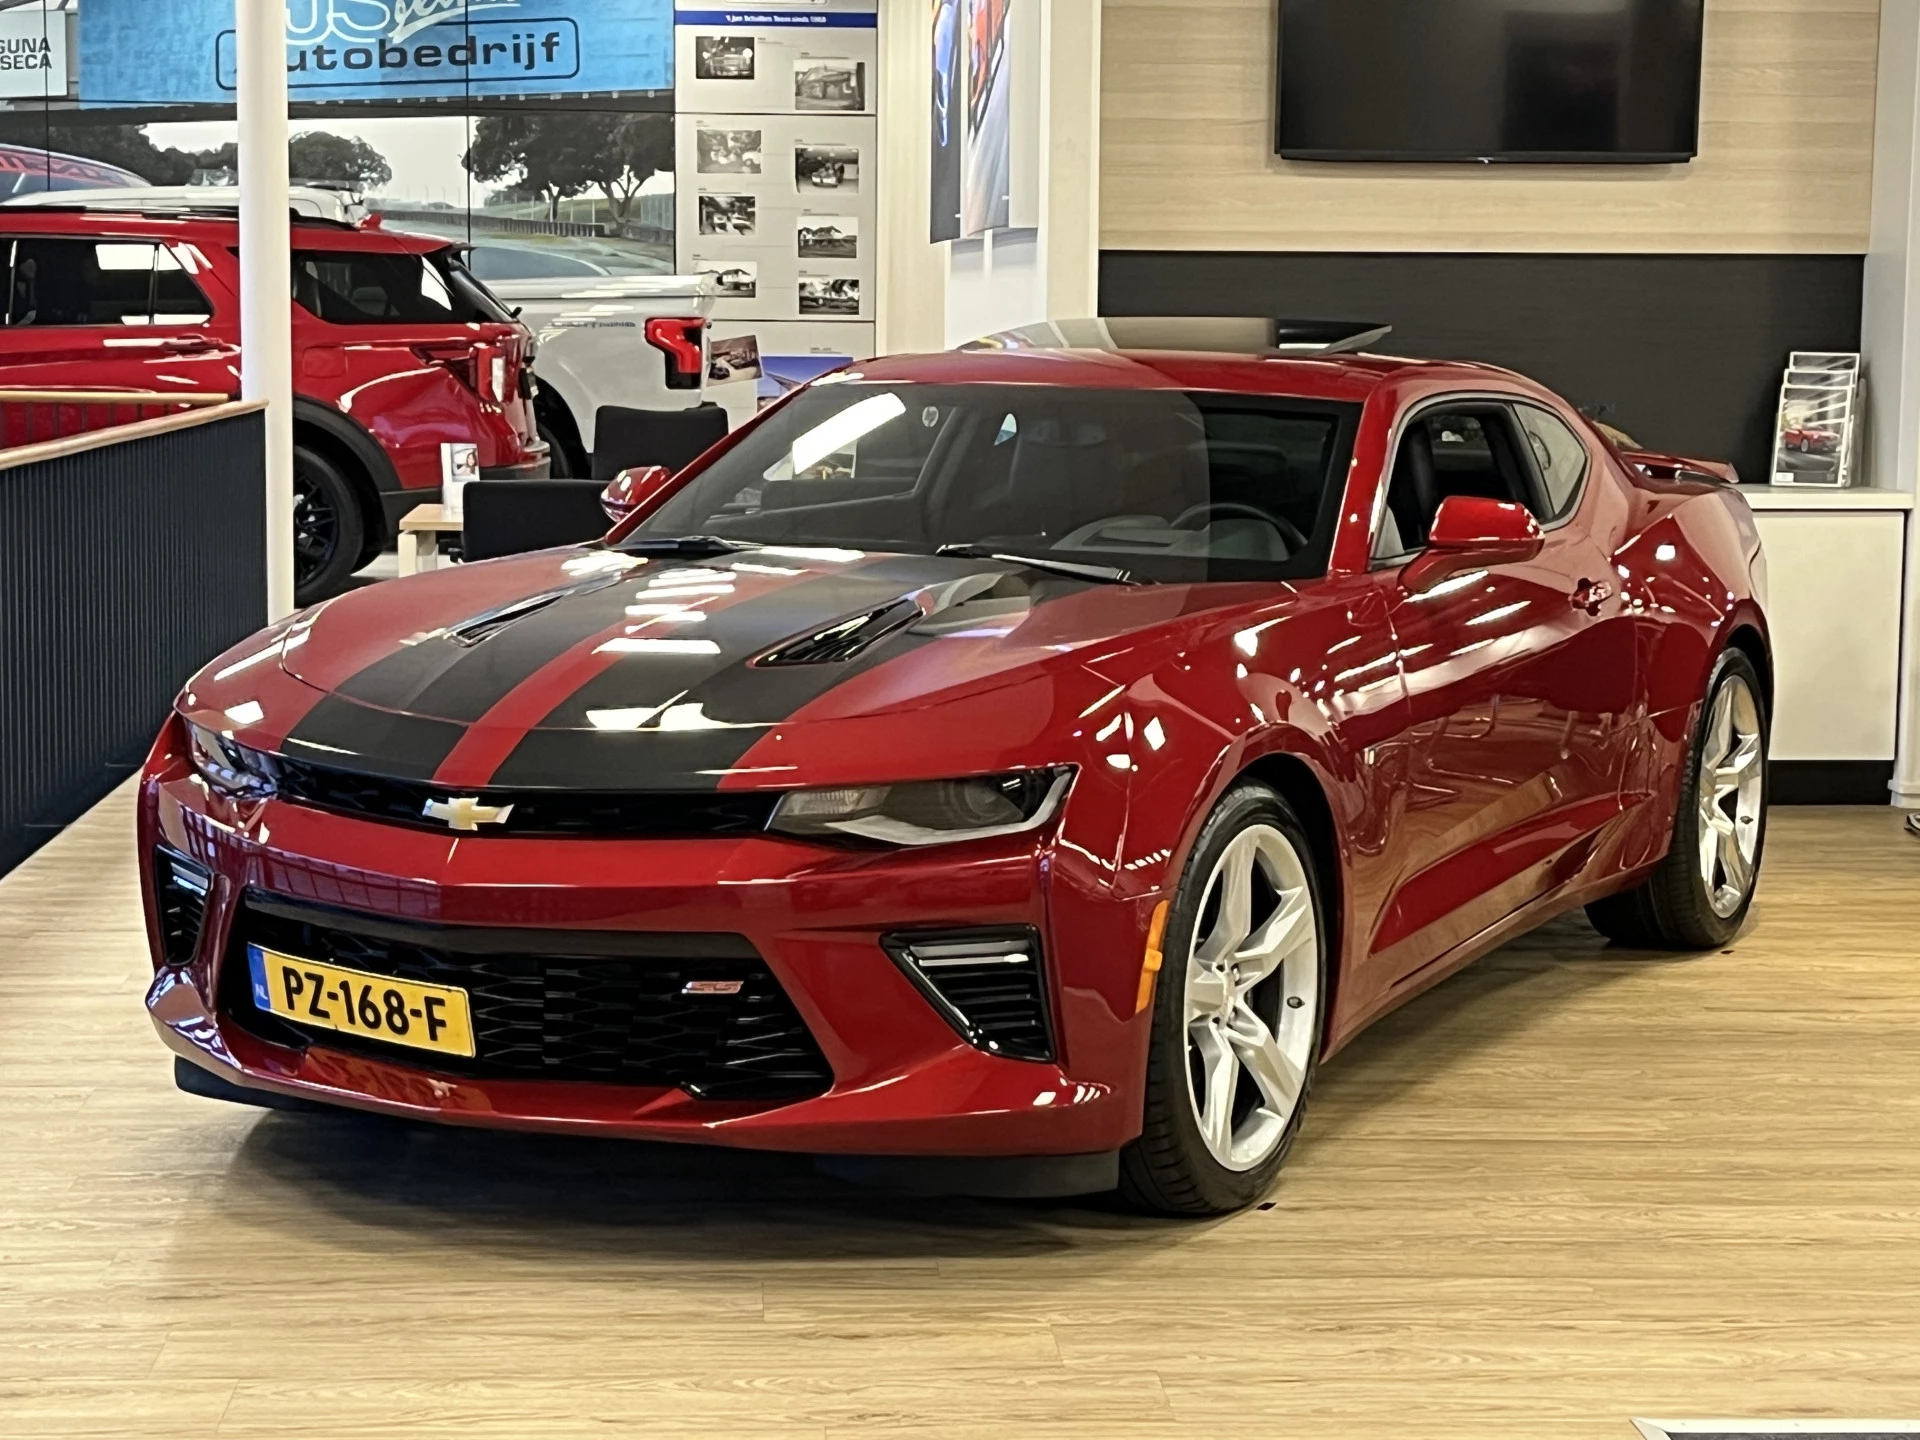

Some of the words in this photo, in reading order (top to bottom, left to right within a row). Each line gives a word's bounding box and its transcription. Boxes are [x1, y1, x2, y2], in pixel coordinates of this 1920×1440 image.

[0, 53, 52, 70] SECA
[234, 32, 560, 74] utobedrijf
[282, 966, 447, 1041] PZ-168-F
